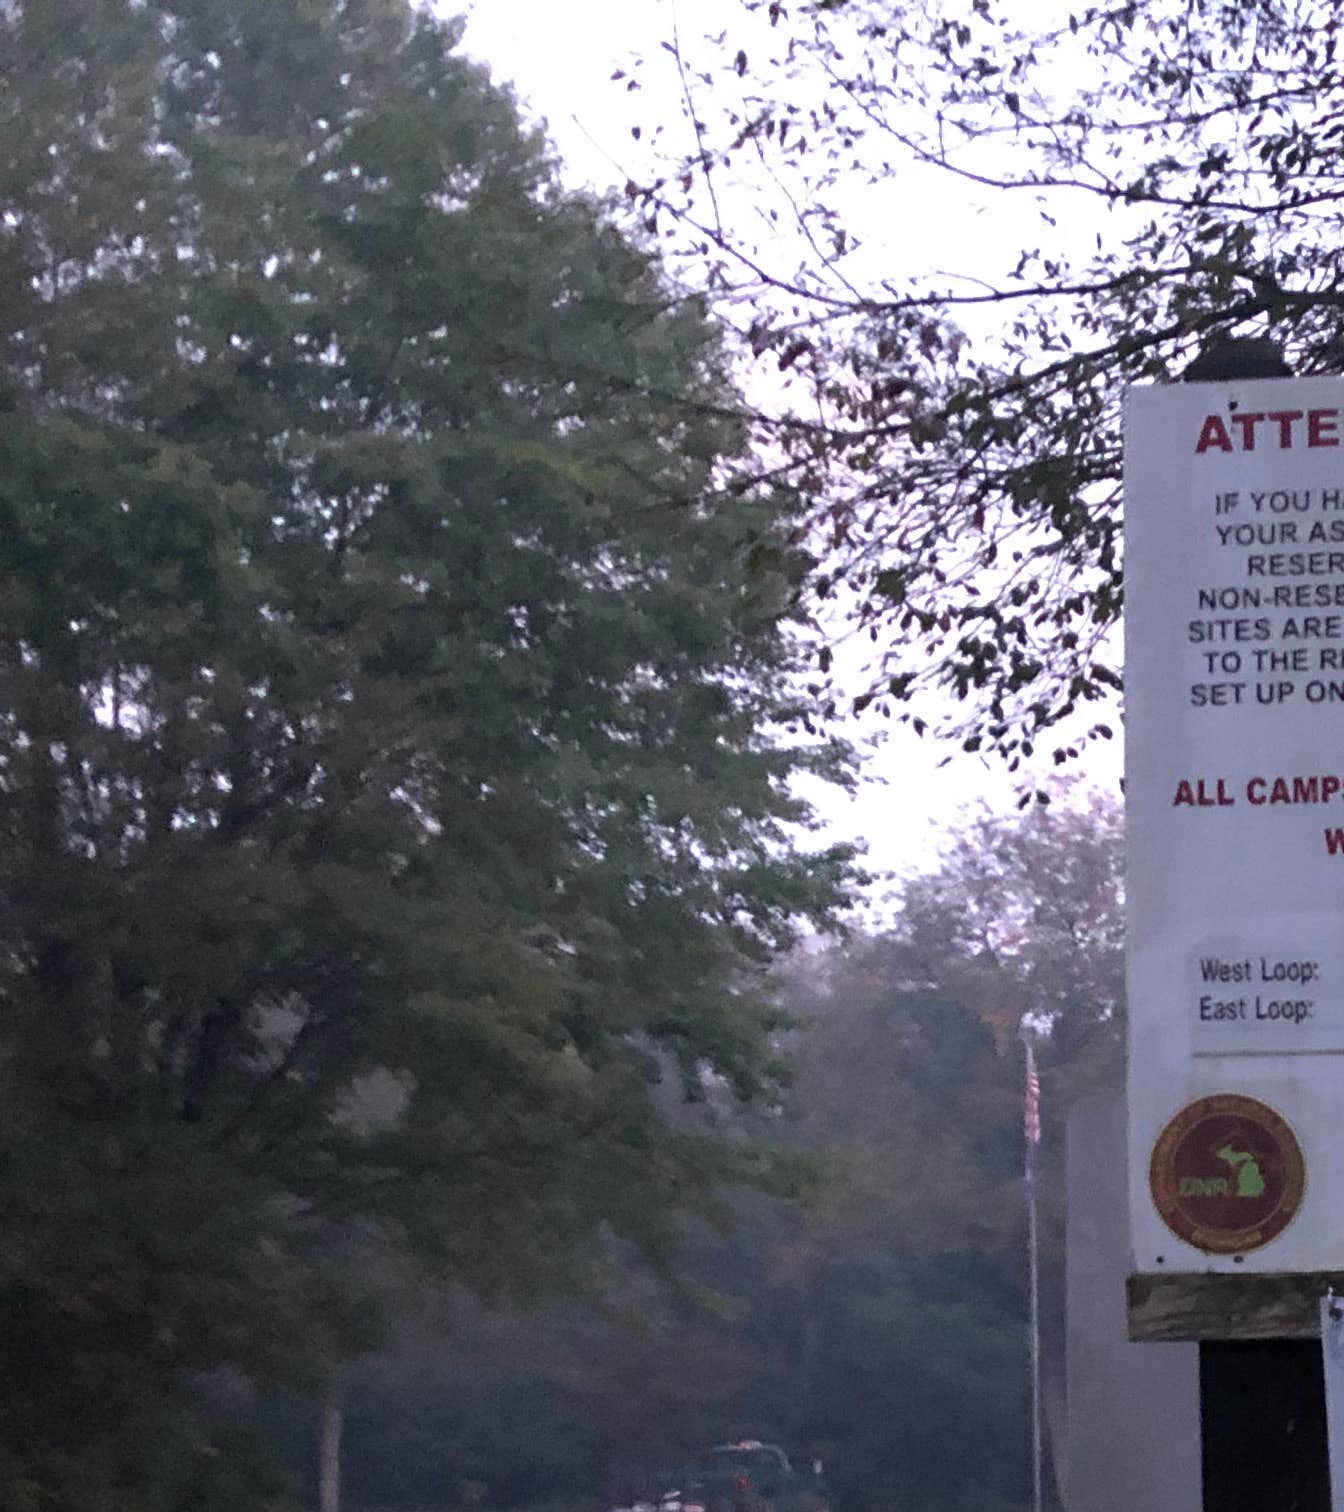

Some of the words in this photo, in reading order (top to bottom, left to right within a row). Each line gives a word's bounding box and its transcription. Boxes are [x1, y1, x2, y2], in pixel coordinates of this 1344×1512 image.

[1215, 492, 1240, 516] IF
[1249, 490, 1309, 514] YOU
[1215, 521, 1297, 547] YOUR
[1188, 617, 1272, 644] SITES
[1281, 615, 1342, 639] ARE
[1204, 650, 1243, 674] TO
[1252, 648, 1310, 673] THE
[1190, 682, 1246, 707] SET
[1254, 681, 1293, 705] UP
[1302, 679, 1344, 703] ON
[1172, 778, 1236, 807] ALL
[1199, 957, 1252, 982] West
[1260, 957, 1319, 986] Loop:
[1199, 995, 1248, 1021] East
[1256, 995, 1313, 1024] Loop:
